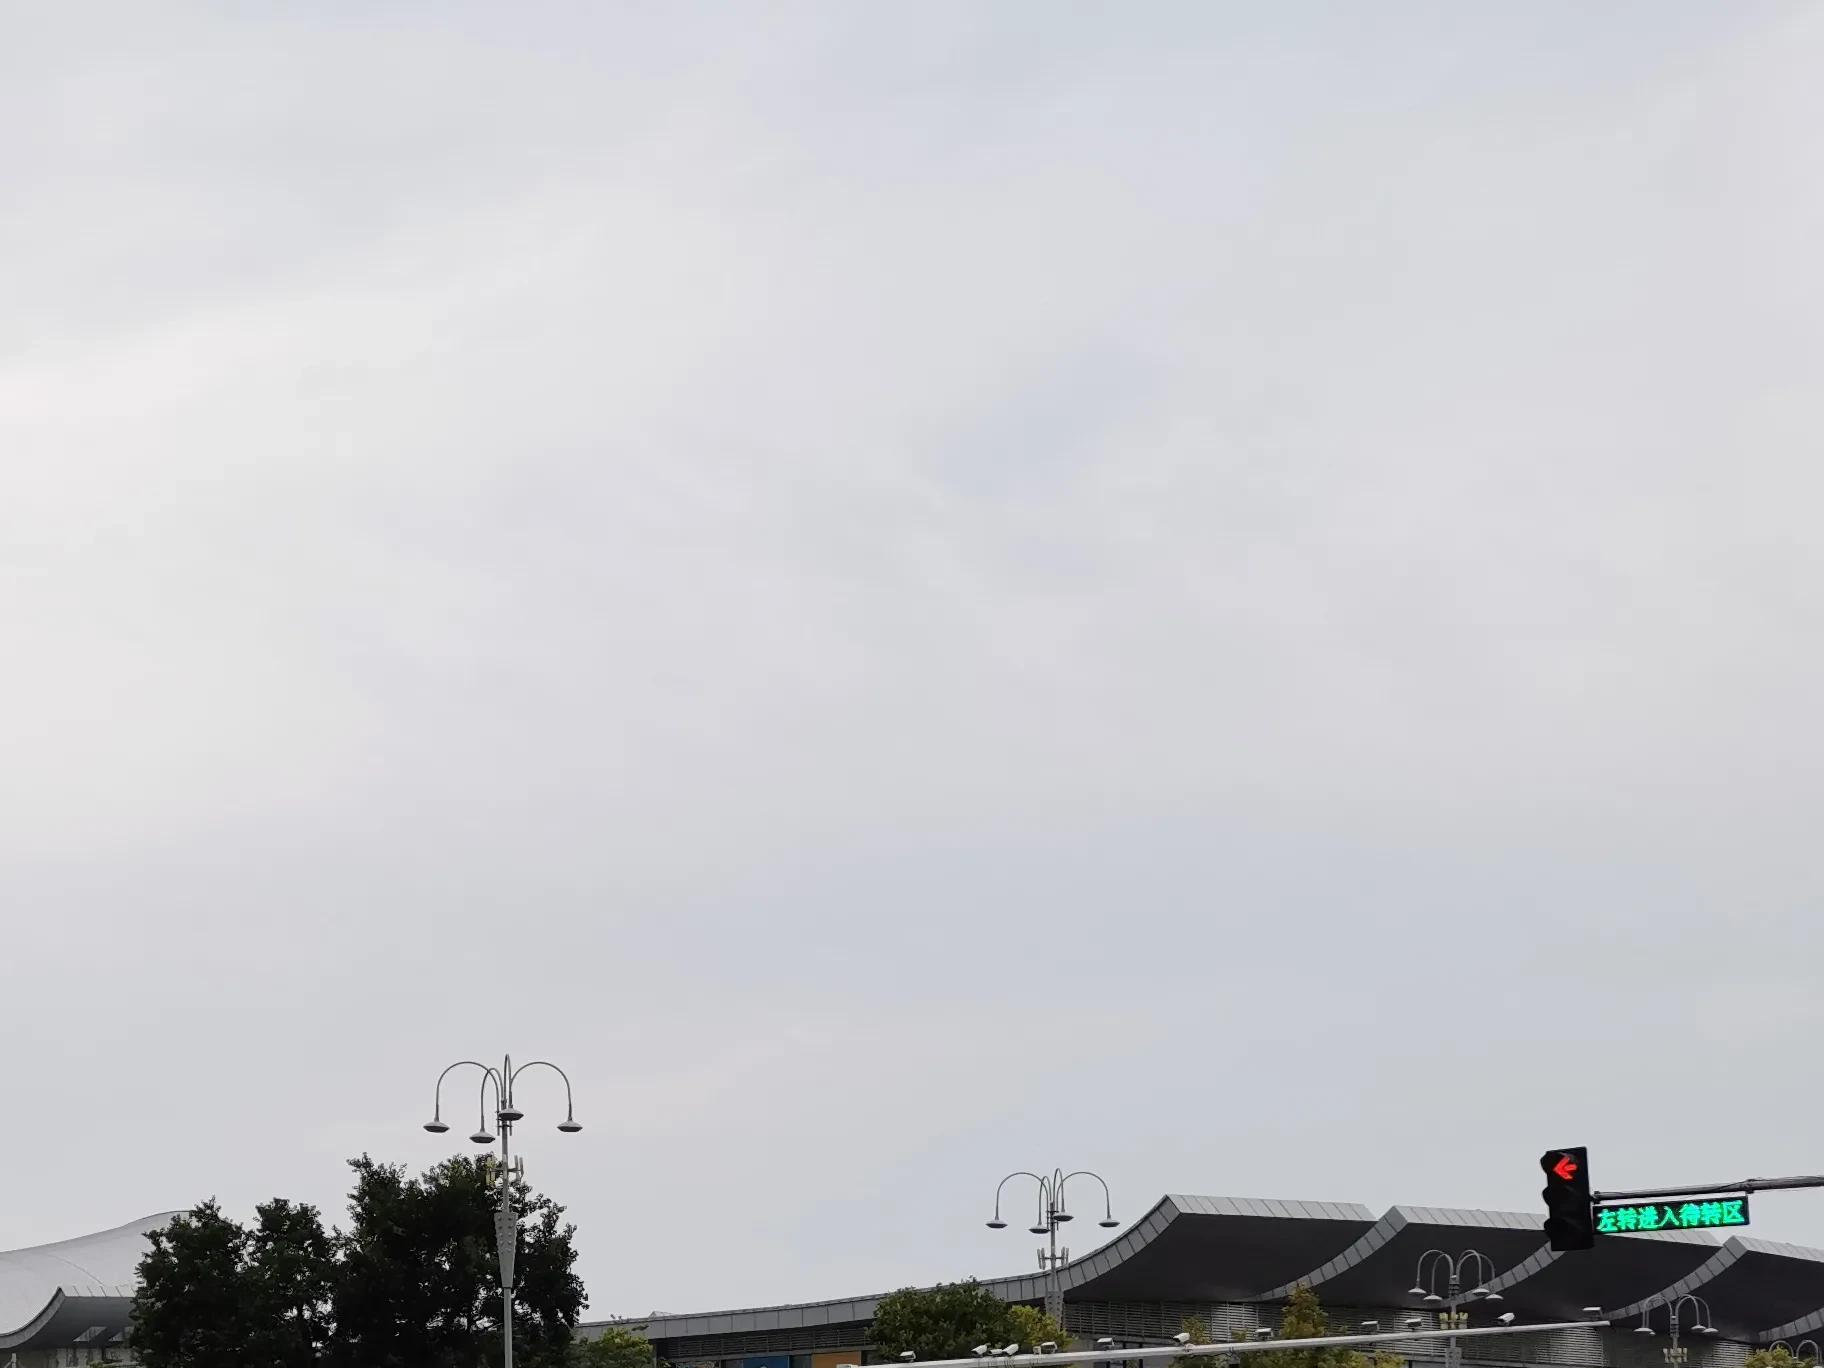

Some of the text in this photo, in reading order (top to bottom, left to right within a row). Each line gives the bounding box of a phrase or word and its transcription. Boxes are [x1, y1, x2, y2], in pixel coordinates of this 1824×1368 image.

[1597, 1200, 1745, 1232] 左转进入待转区
